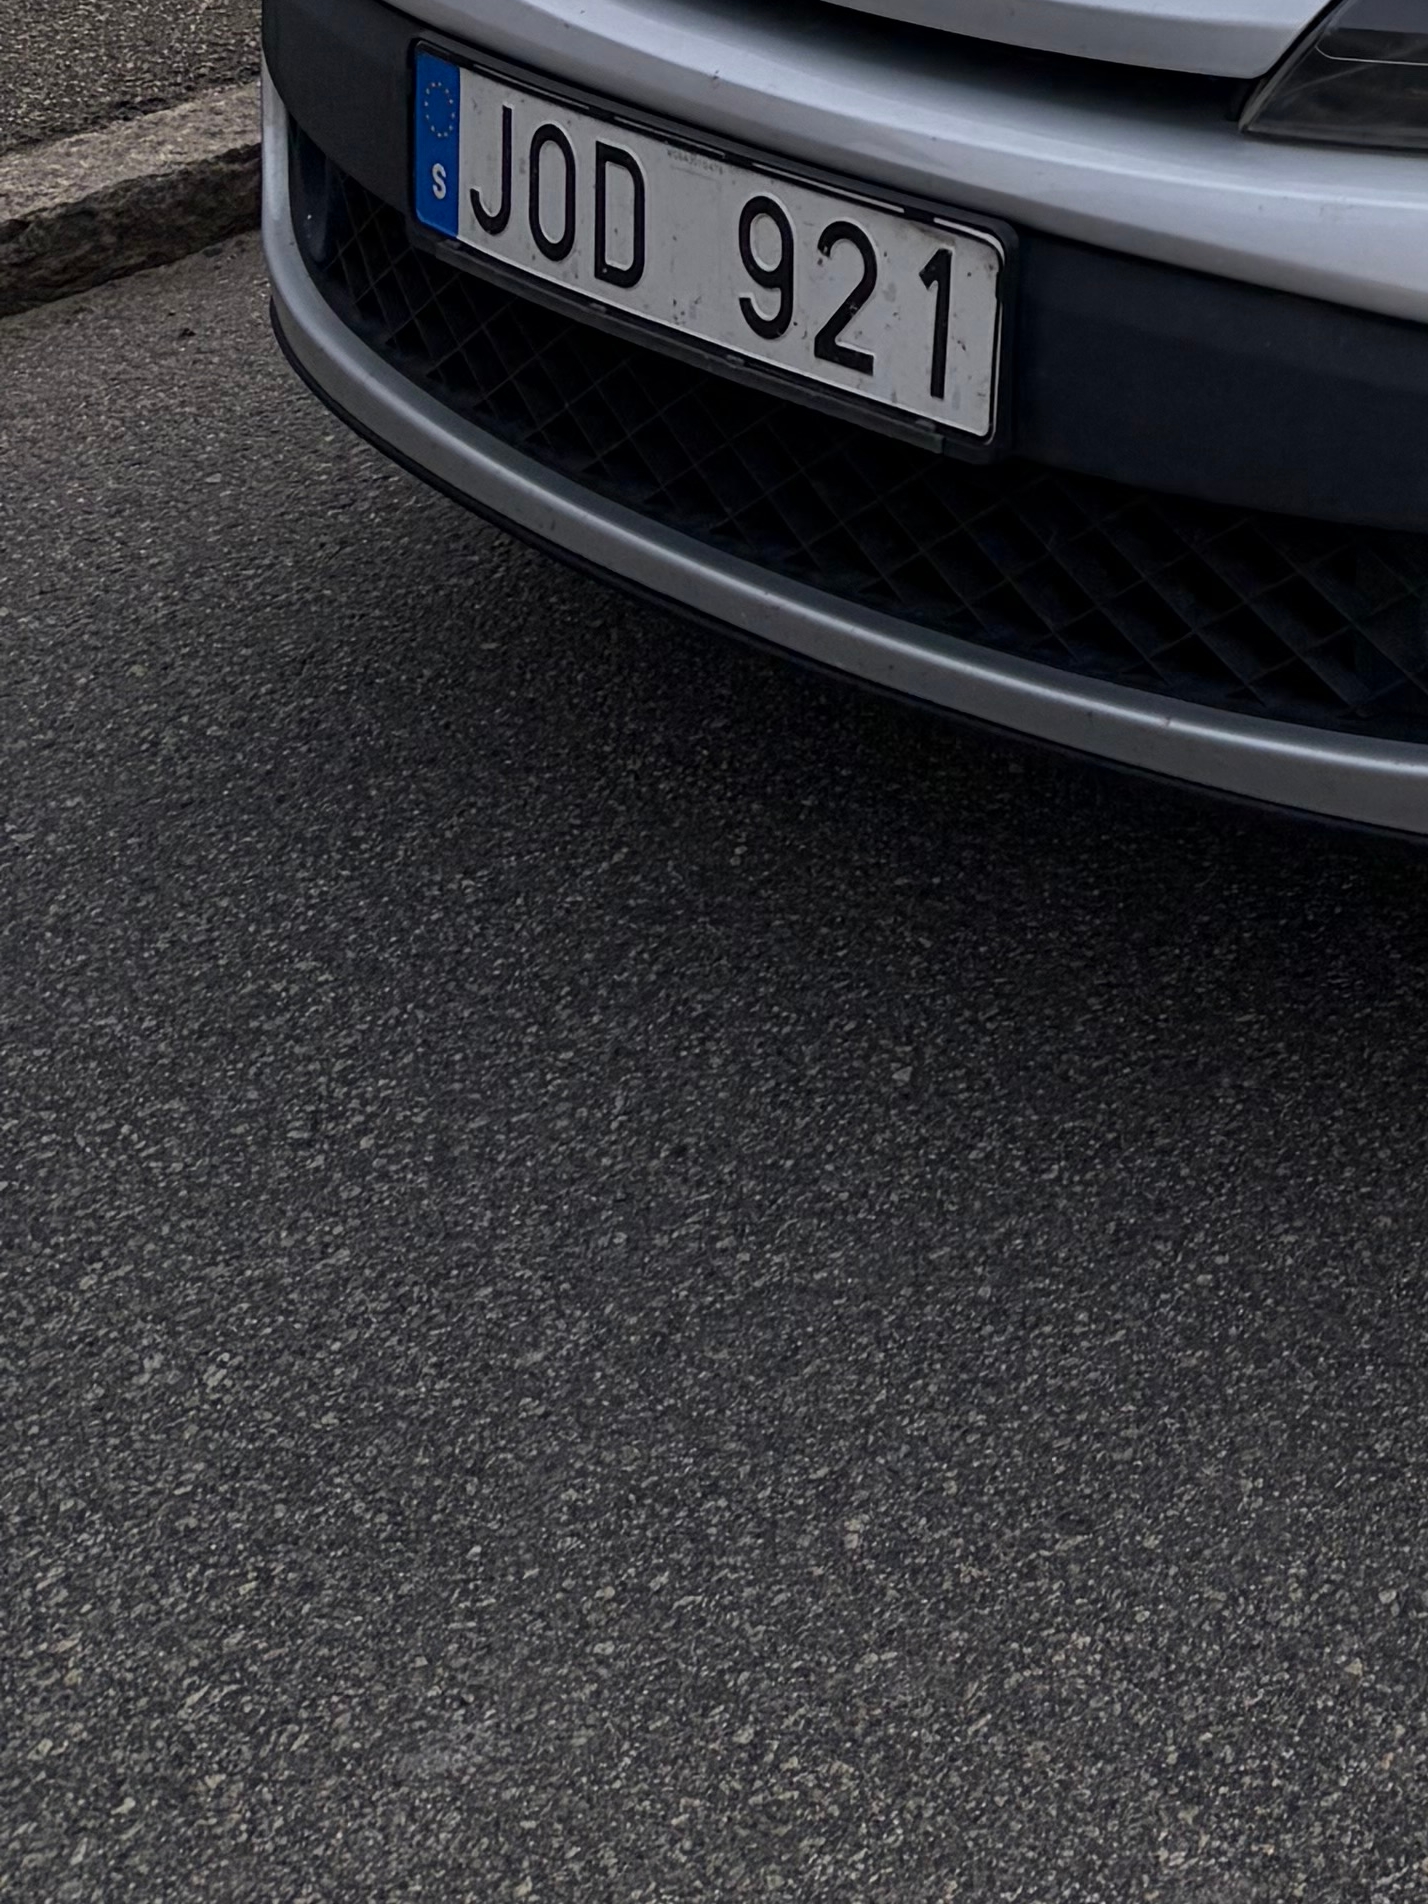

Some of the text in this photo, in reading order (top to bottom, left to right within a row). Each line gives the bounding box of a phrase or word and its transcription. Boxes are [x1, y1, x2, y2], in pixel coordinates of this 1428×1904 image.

[431, 162, 448, 200] S
[469, 103, 953, 400] JOD 921
